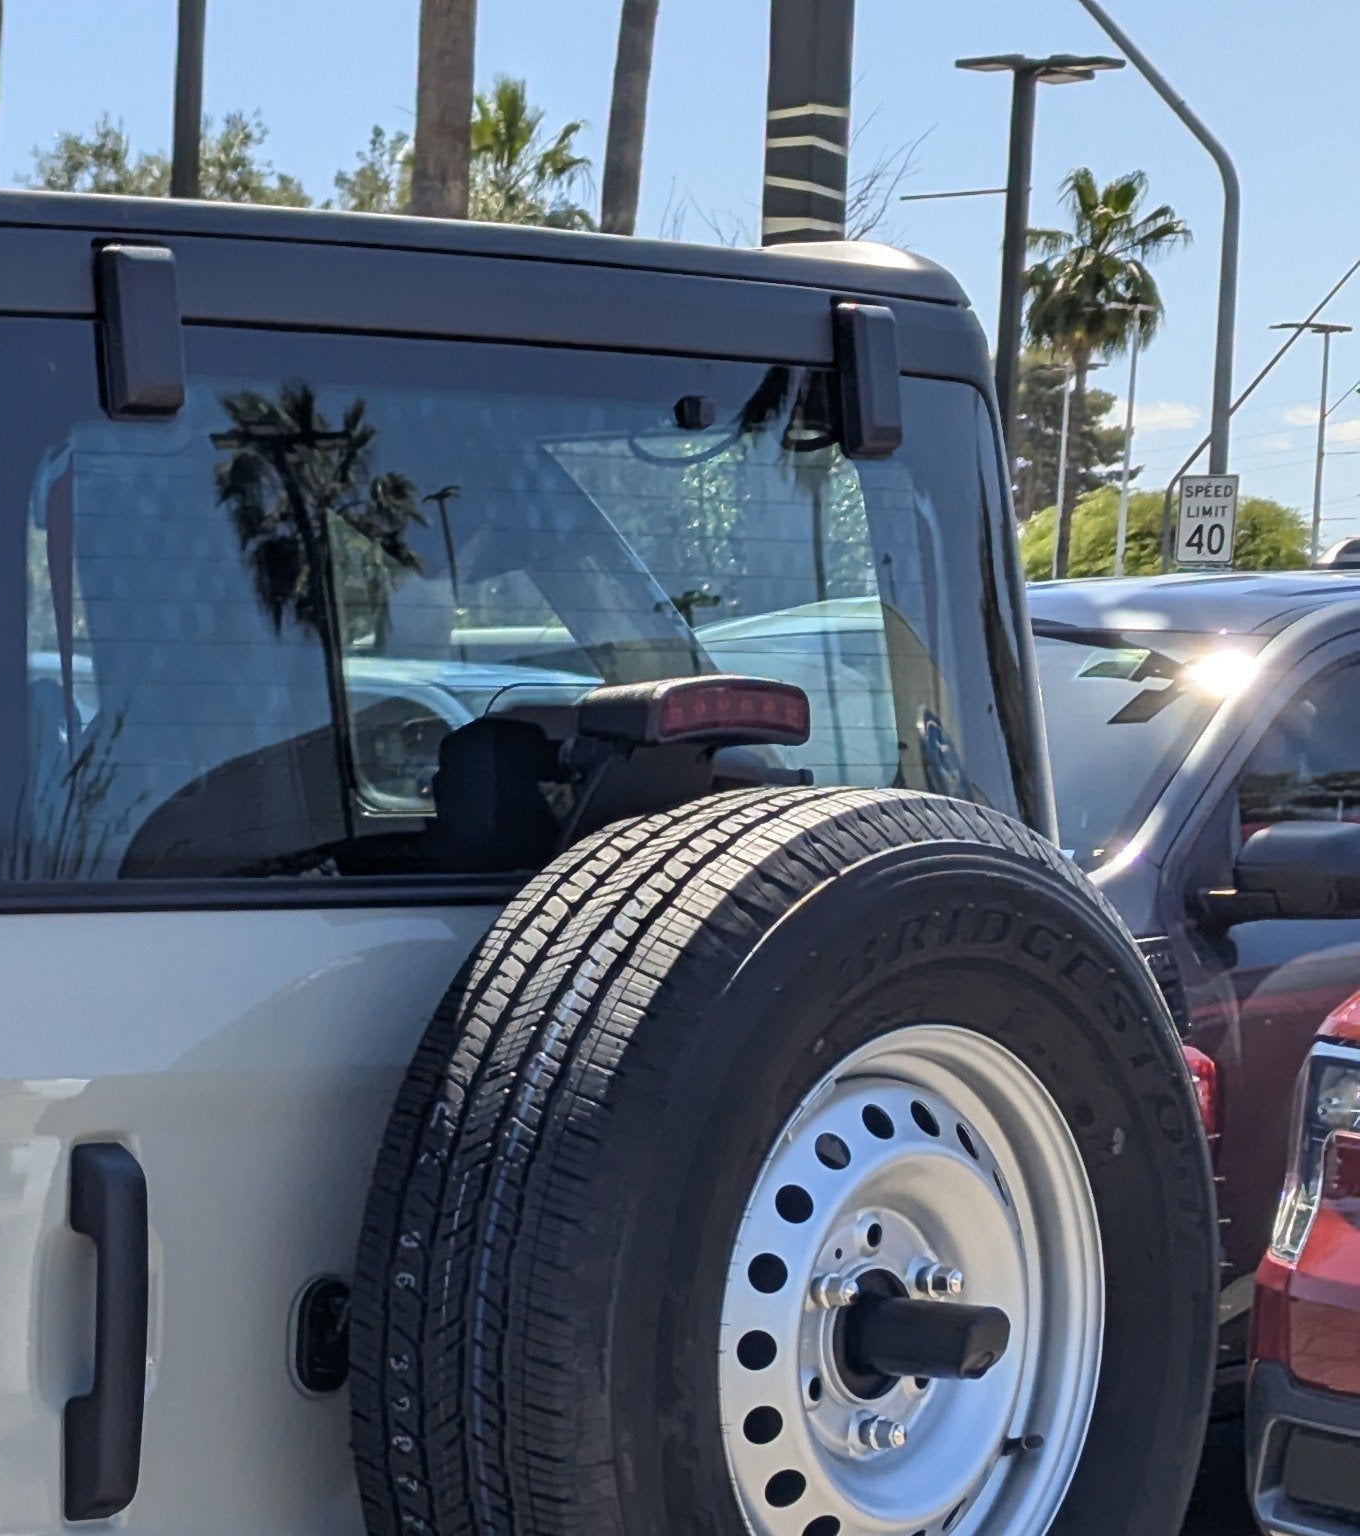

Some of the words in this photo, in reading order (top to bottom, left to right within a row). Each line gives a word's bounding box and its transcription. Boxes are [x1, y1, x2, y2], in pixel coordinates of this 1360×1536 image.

[1184, 484, 1233, 499] SPEED
[1185, 505, 1229, 518] LIMIT
[1185, 523, 1226, 555] 40
[834, 902, 1206, 1285] BRIDGESTON
